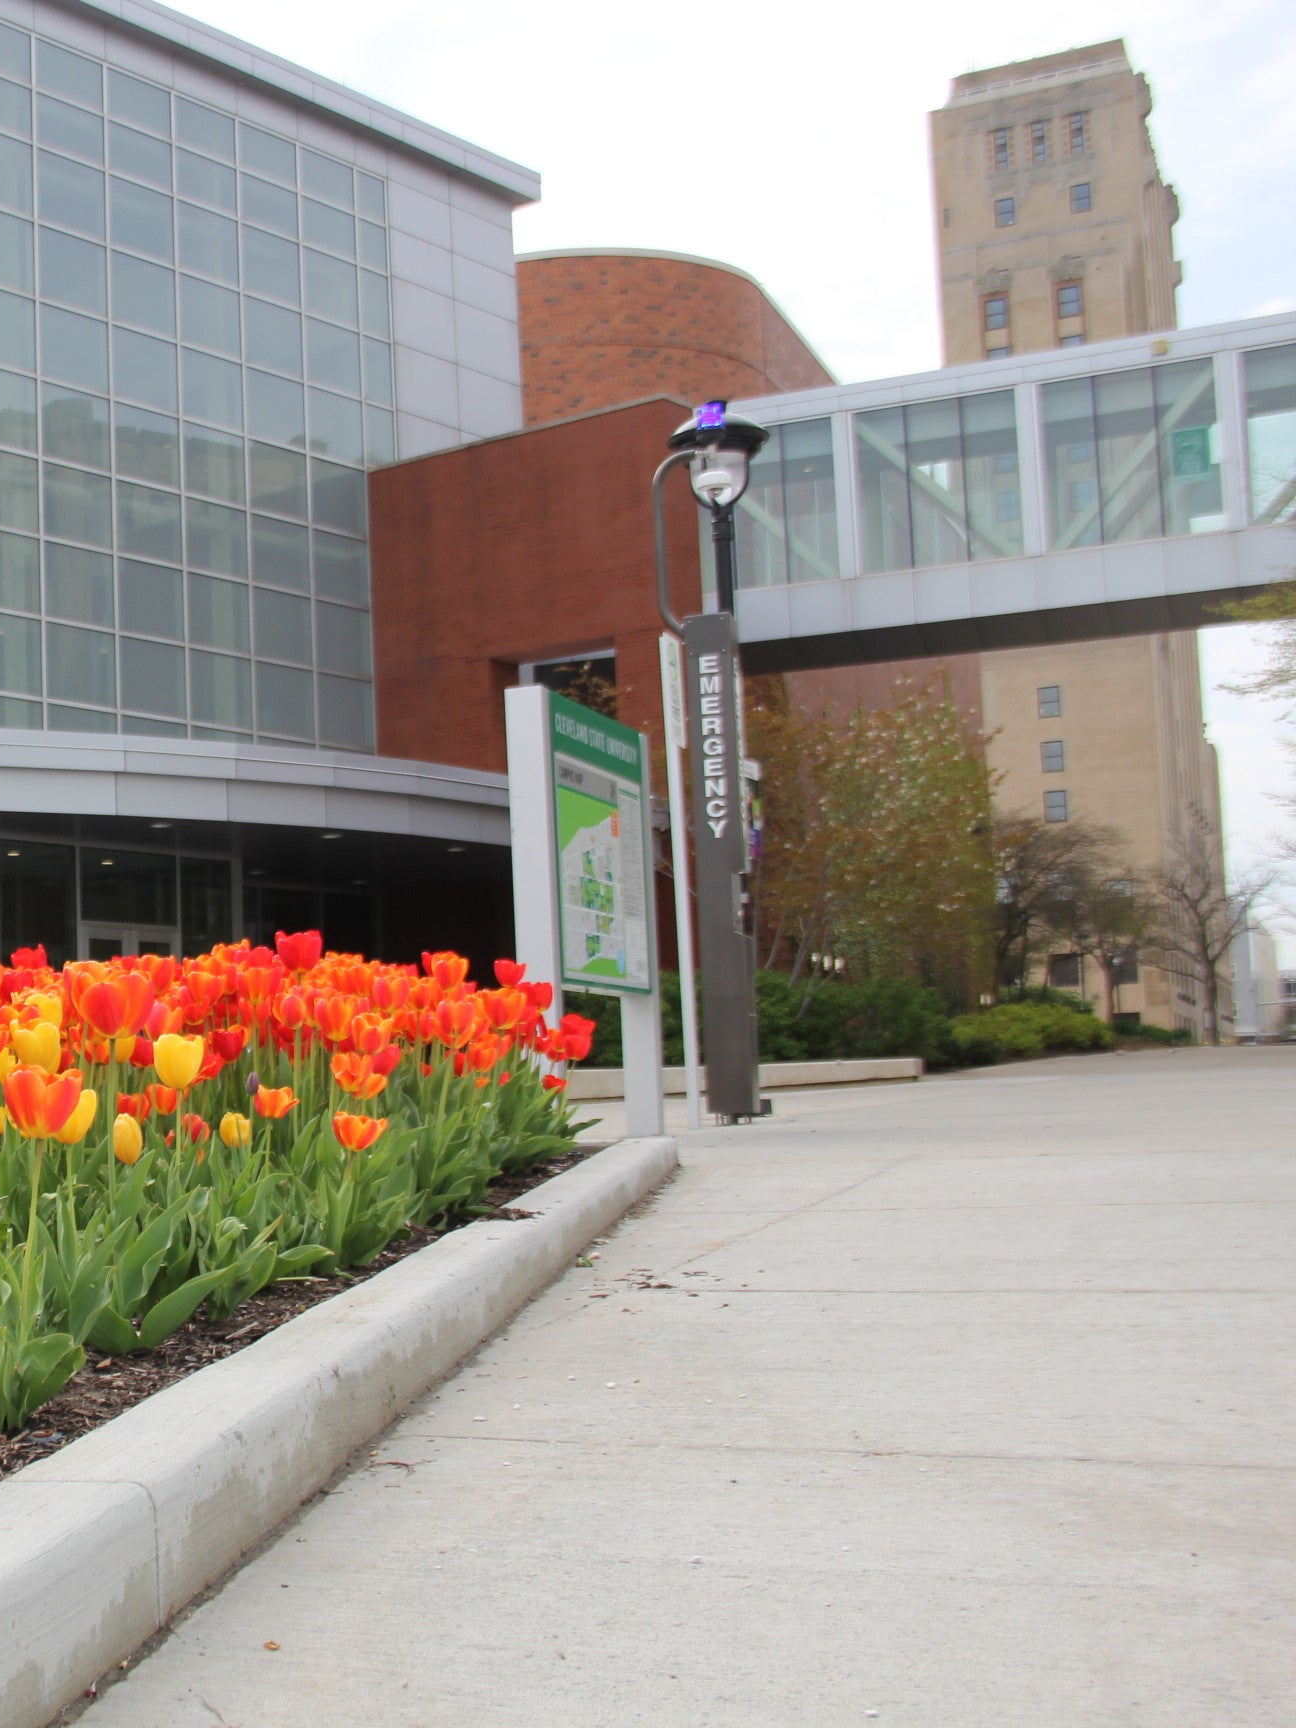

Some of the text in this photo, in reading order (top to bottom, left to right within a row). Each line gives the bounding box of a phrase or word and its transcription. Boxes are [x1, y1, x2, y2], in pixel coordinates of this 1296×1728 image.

[555, 712, 588, 745] CLEVELAND
[588, 728, 606, 752] STATE
[698, 655, 728, 839] EMERGENCY
